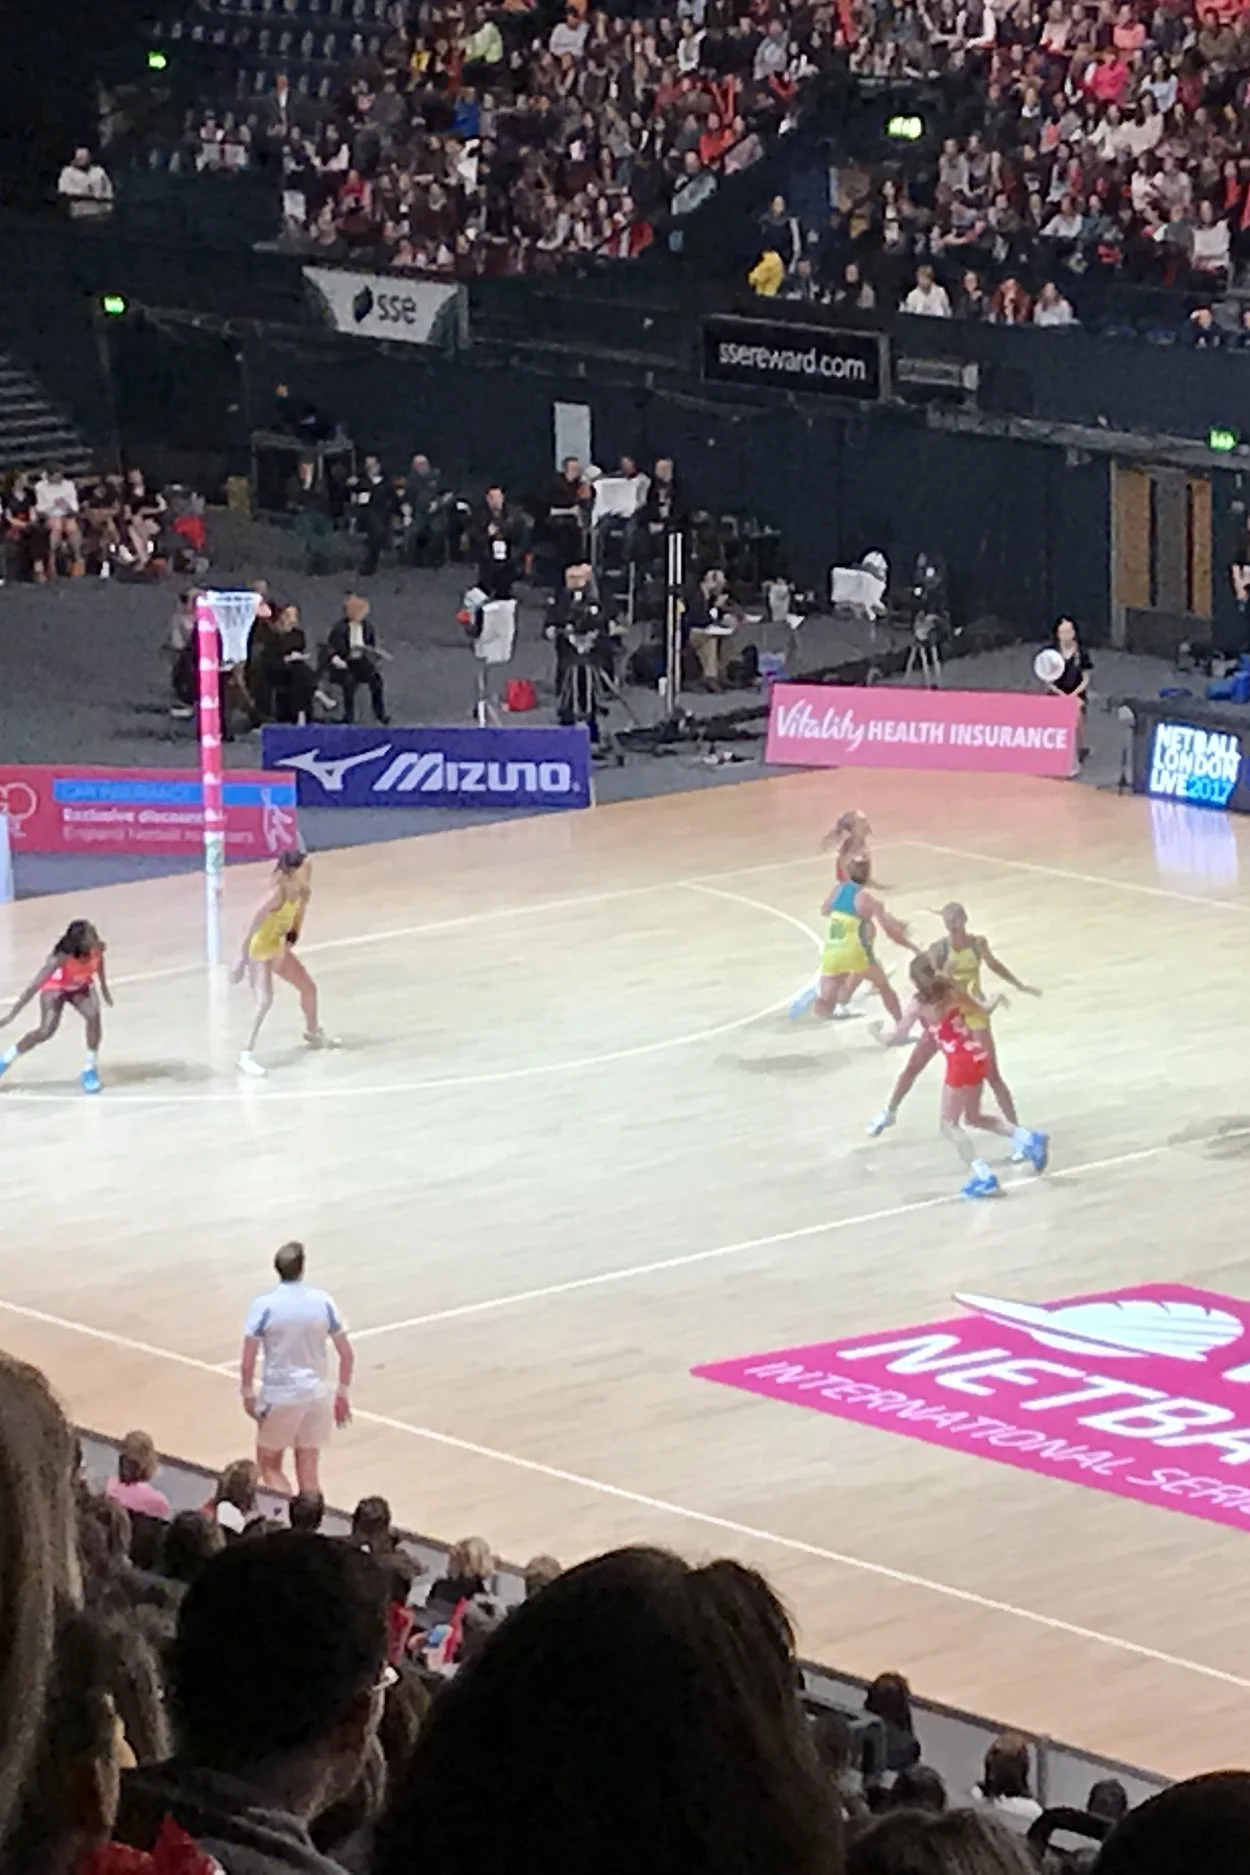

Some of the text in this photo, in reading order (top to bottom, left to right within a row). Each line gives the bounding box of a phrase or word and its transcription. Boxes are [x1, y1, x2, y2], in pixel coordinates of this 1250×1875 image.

[377, 294, 416, 324] sse
[719, 342, 866, 381] ssereward.com
[776, 699, 1068, 753] Vitality HEALTH INSURANCE
[1156, 723, 1239, 756] NETBALL
[1150, 767, 1188, 796] LIVE
[1153, 745, 1241, 783] LONDON
[744, 1361, 1136, 1476] INTERNATIONAL
